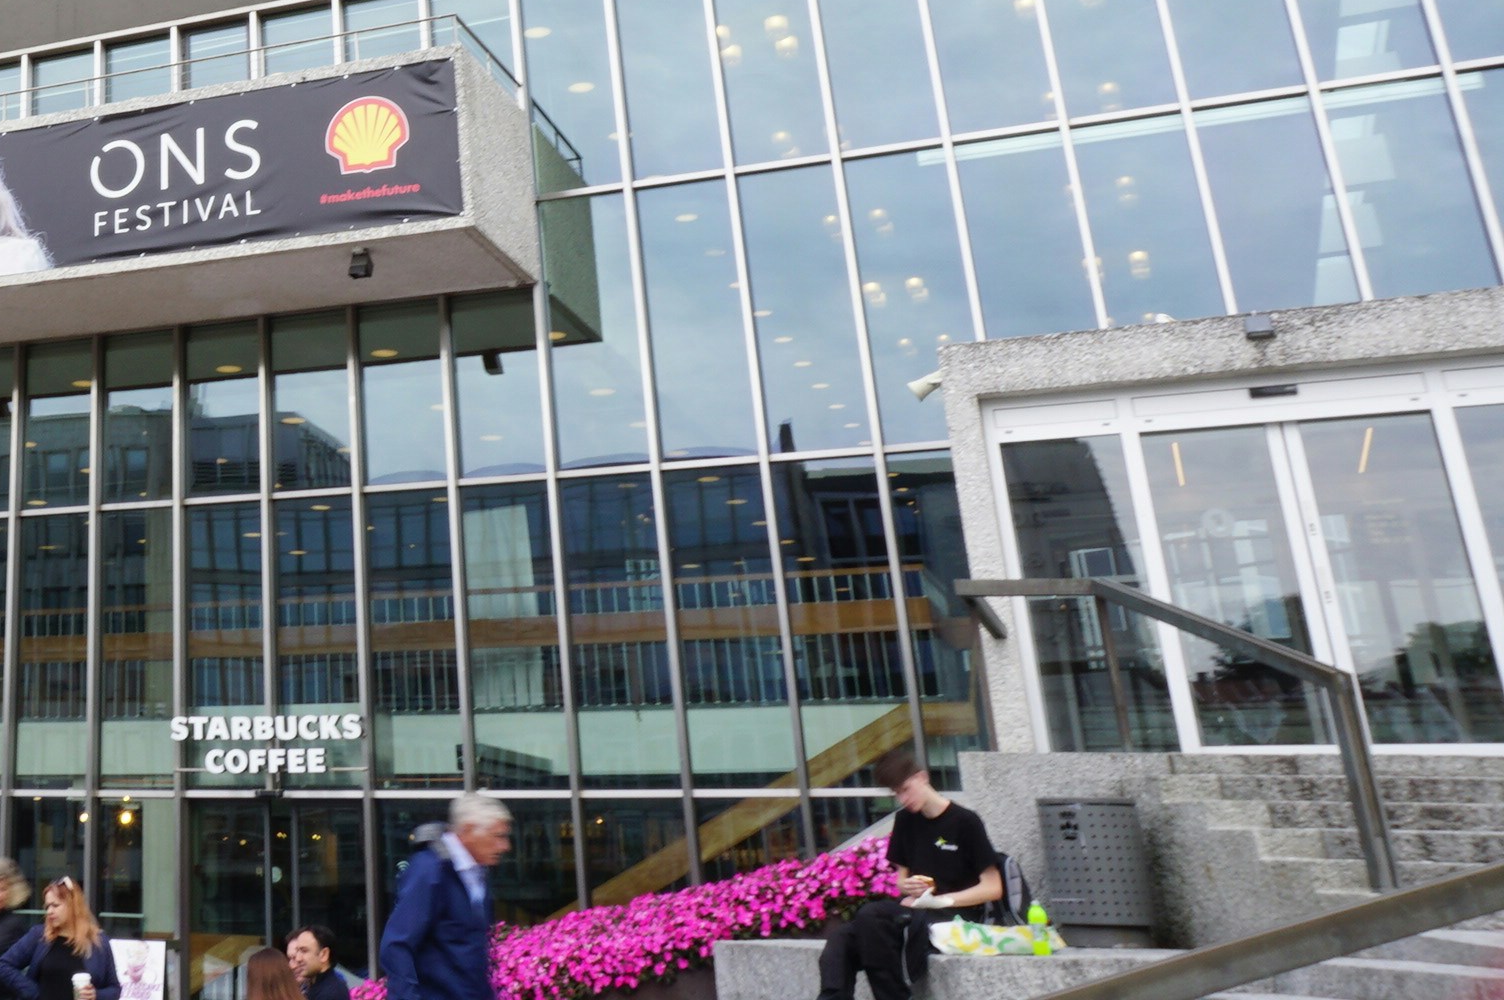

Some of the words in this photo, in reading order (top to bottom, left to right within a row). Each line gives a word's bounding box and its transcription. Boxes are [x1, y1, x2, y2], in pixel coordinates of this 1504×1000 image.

[89, 119, 262, 199] ONS
[319, 184, 421, 204] #makethefuture
[93, 190, 262, 237] FESTIVAL
[170, 713, 364, 742] STARBUCKS
[205, 747, 327, 775] COFFEE
